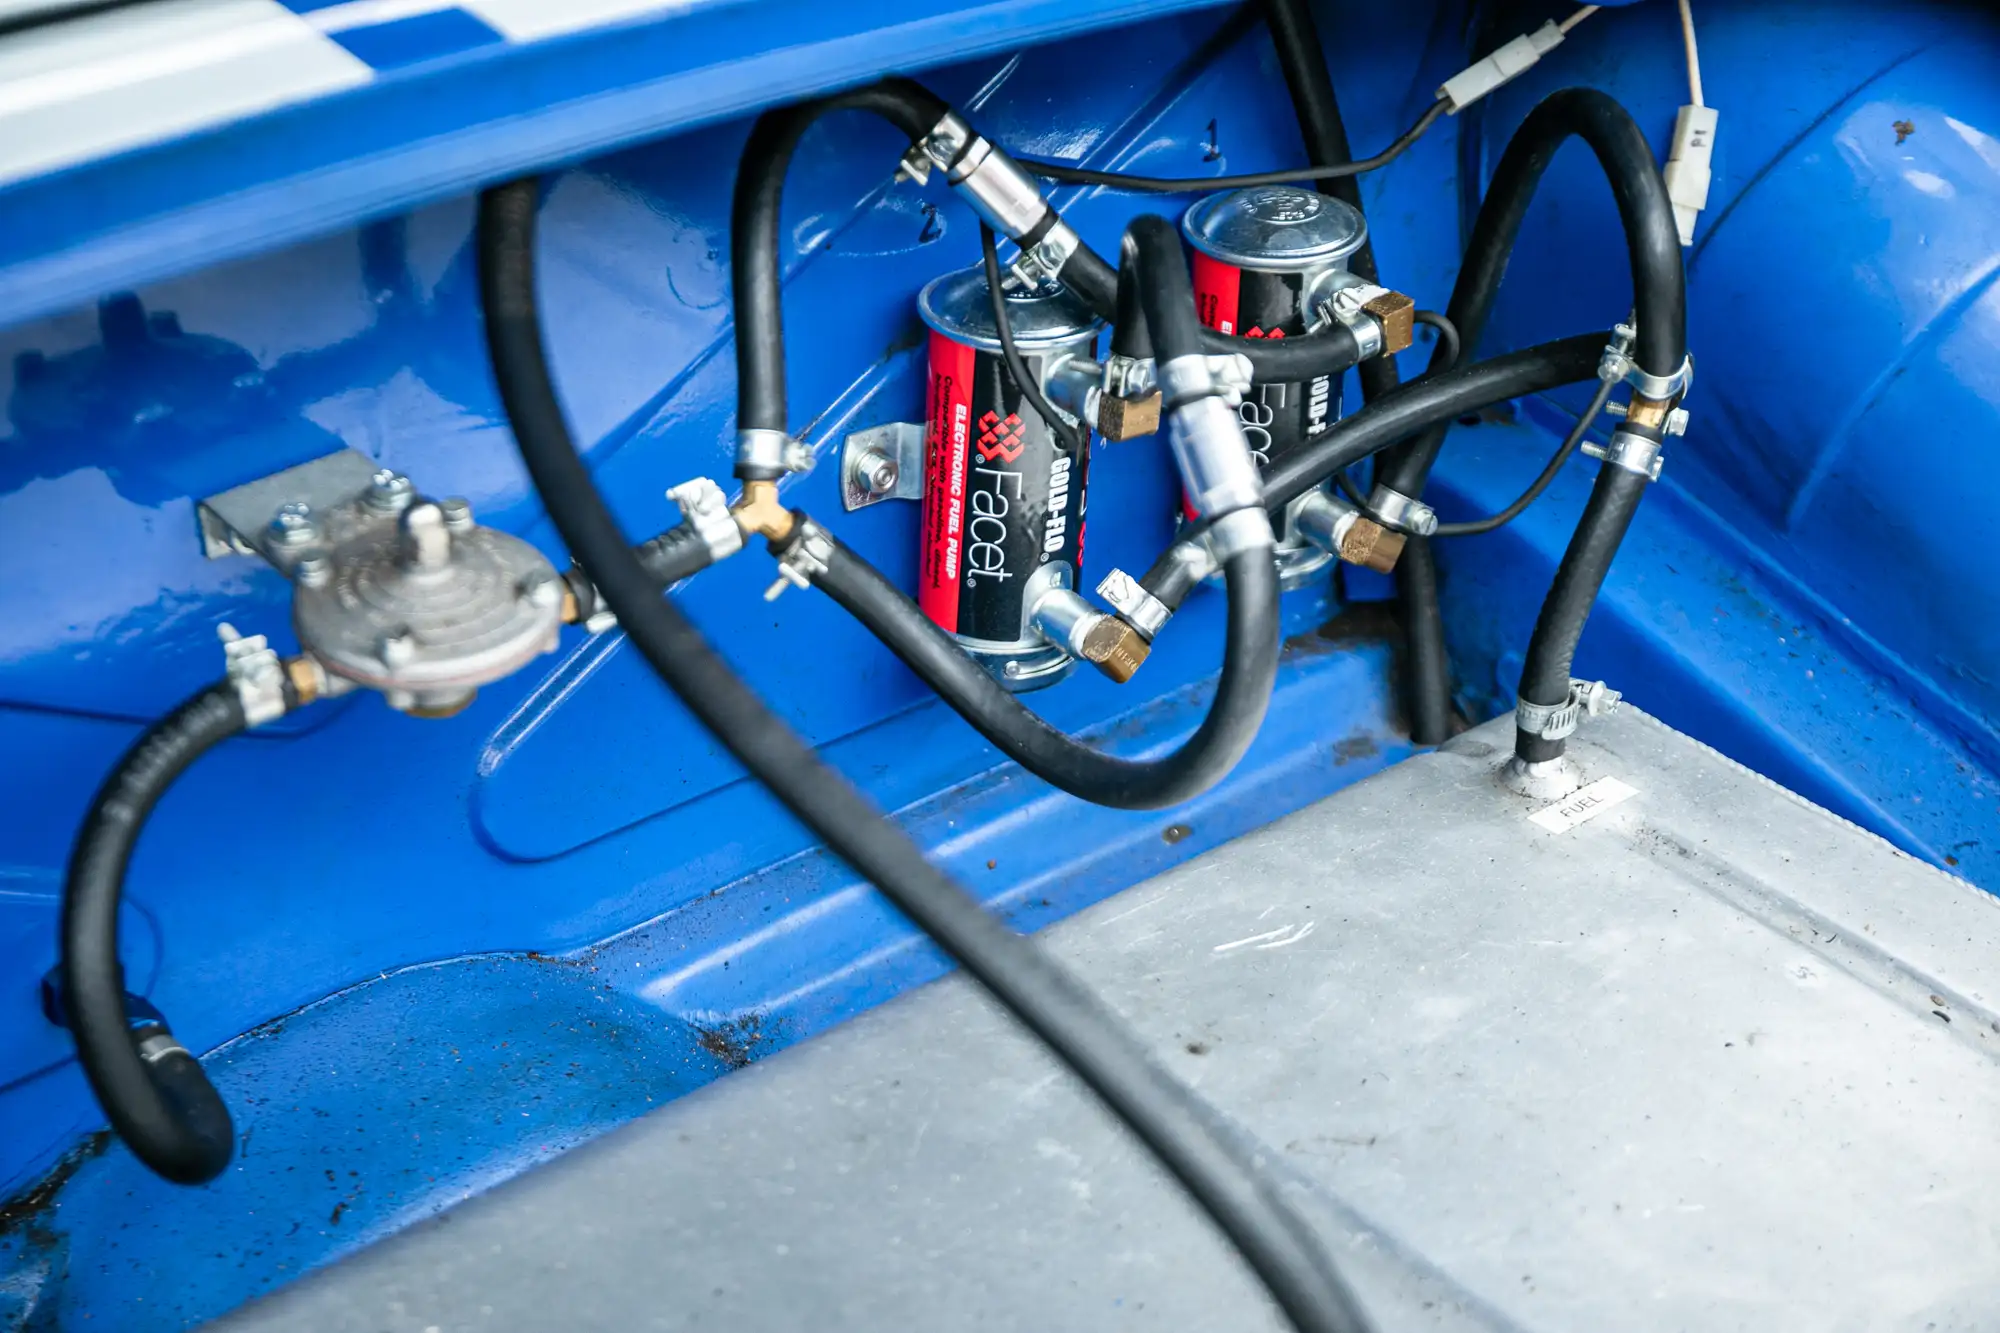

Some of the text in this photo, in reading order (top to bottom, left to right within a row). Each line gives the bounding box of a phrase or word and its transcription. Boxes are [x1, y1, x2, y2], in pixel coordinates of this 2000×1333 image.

[1307, 375, 1330, 435] OLD-F
[939, 455, 947, 483] with
[945, 403, 967, 579] ELECTRONIC FUEL PUMP
[1560, 796, 1605, 818] FUEL
